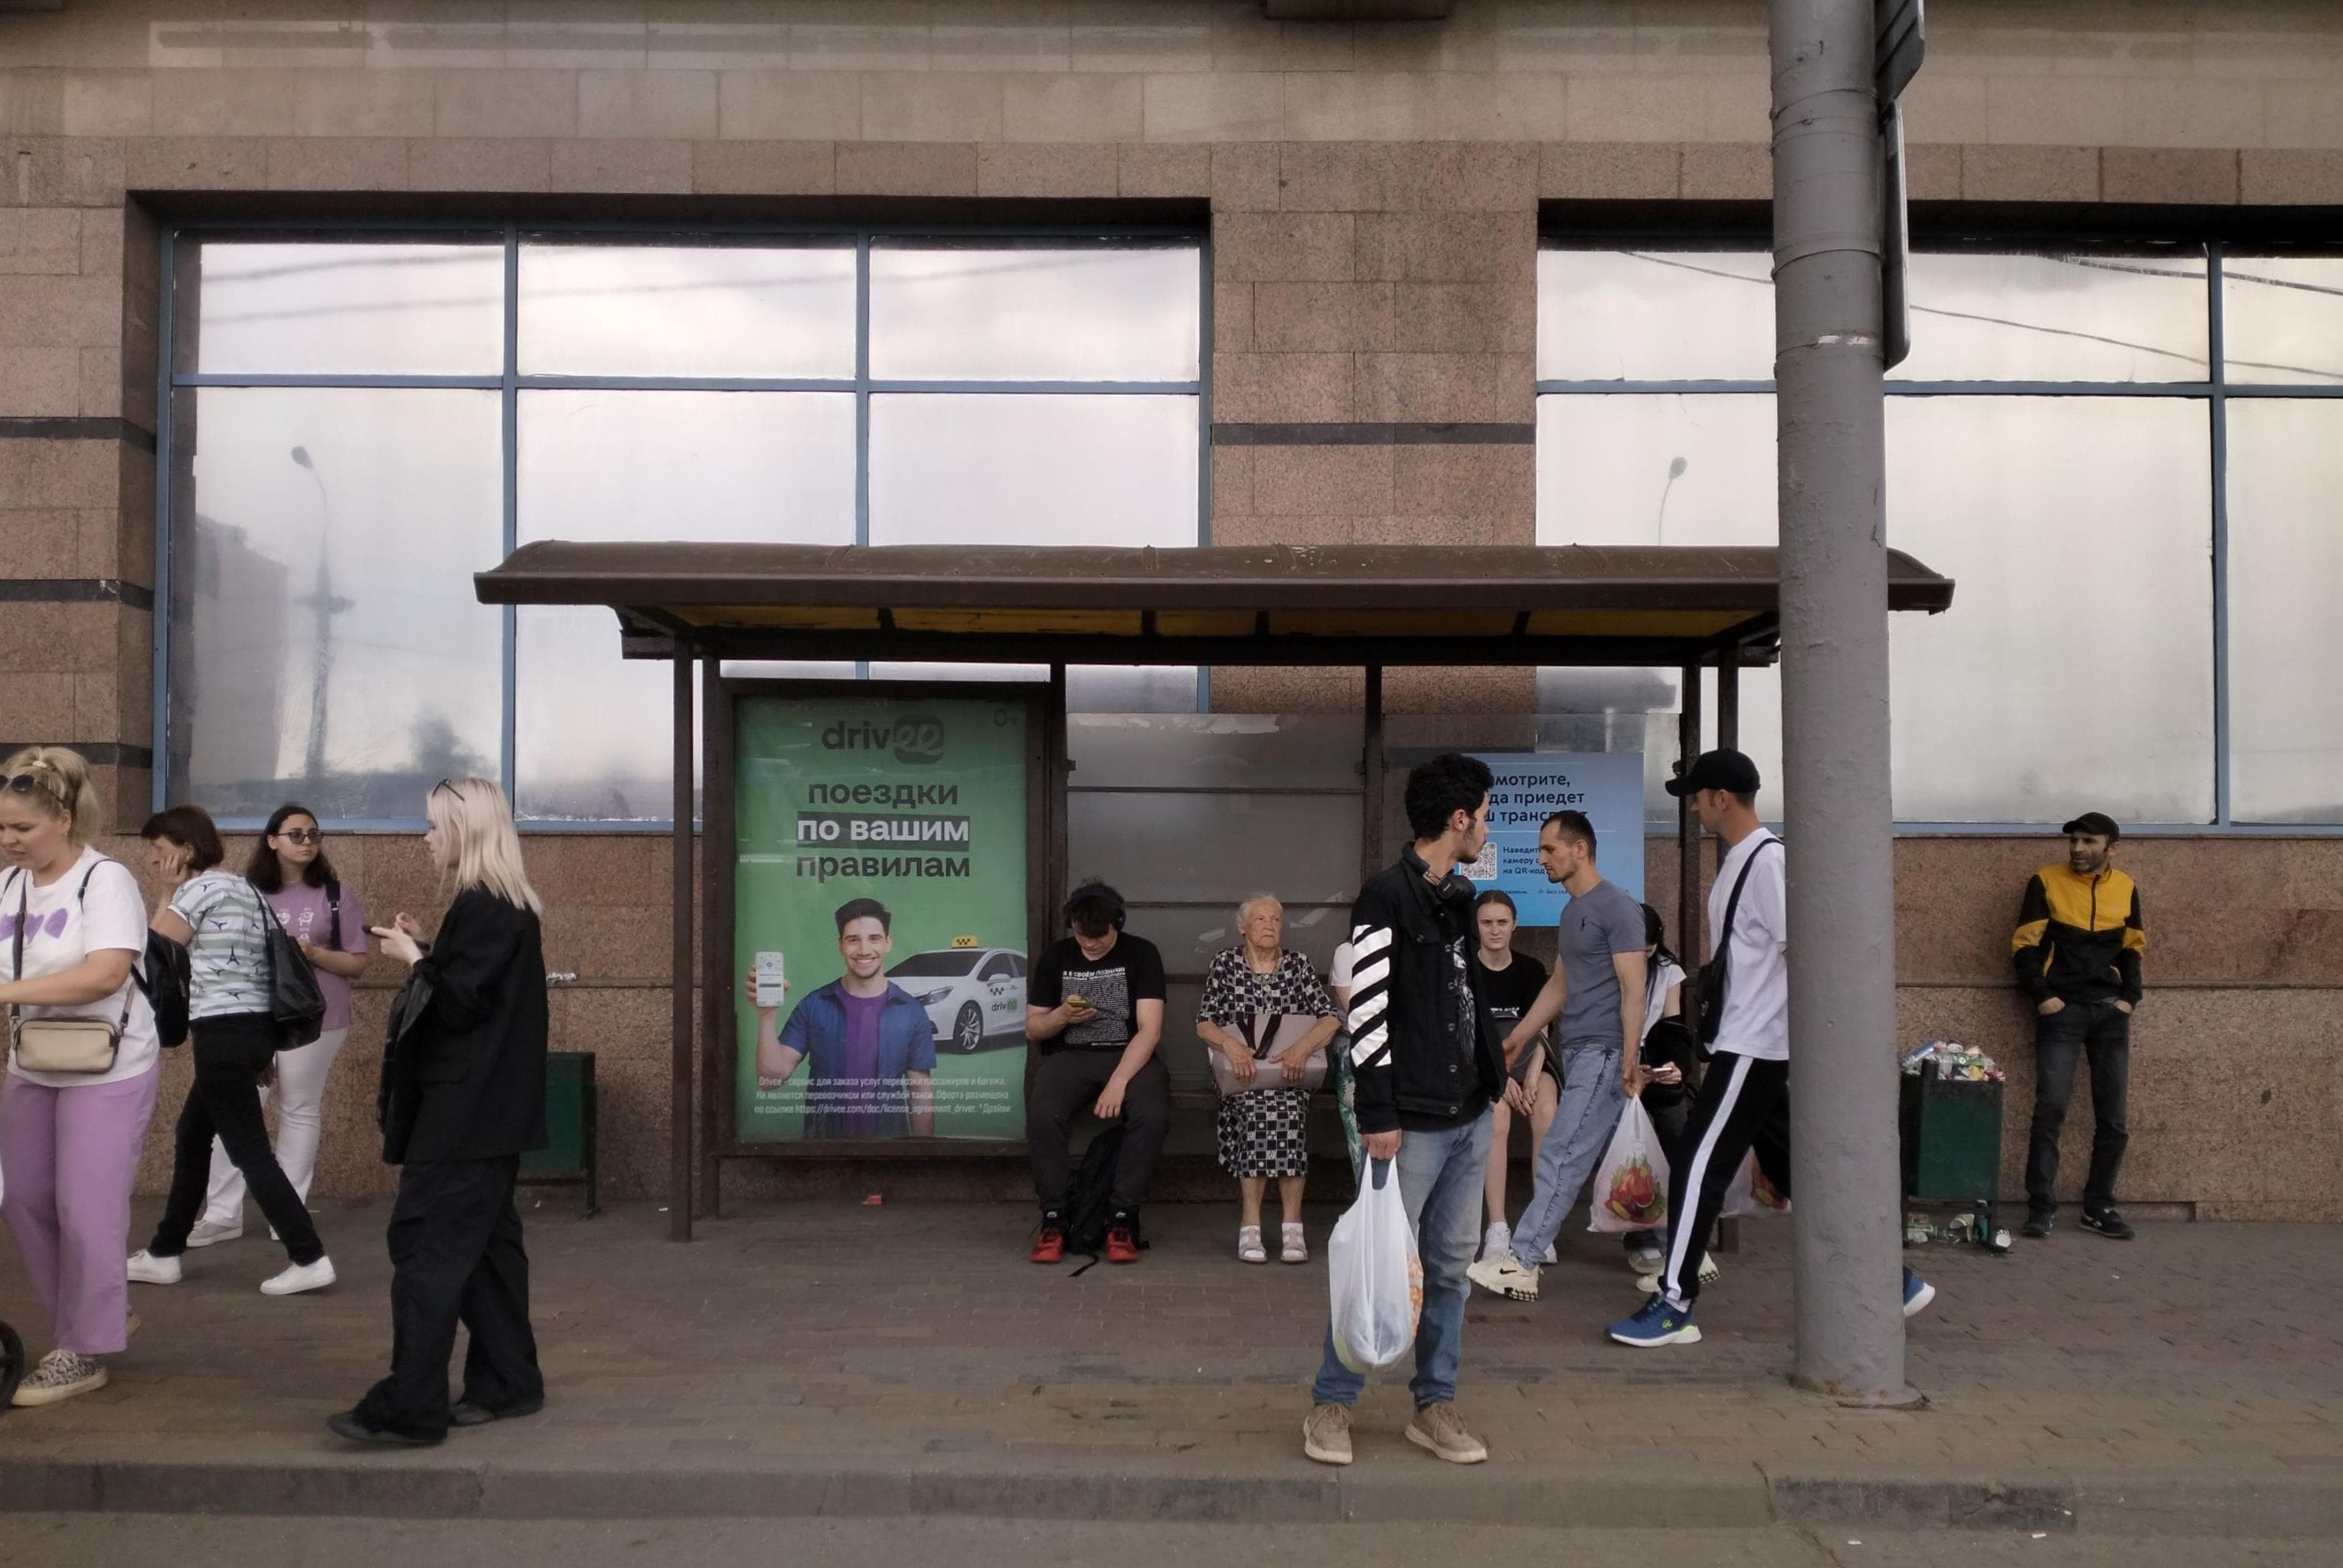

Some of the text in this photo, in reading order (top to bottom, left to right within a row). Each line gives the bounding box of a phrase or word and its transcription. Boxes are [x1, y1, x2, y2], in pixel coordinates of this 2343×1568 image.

[994, 708, 1018, 727] 0+
[1495, 775, 1570, 789] мотрите,
[808, 782, 958, 808] поездки
[1514, 792, 1585, 807] приедет
[797, 819, 969, 841] по вашим
[796, 856, 970, 883] правилам
[1515, 867, 1545, 875] QR-код
[759, 1076, 783, 1086] Drivee
[788, 1078, 815, 1086] сервис
[816, 1078, 832, 1086] для
[860, 1078, 881, 1087] услуг
[882, 1078, 922, 1087] перевозки
[923, 1077, 969, 1087] пассажиров
[756, 1091, 766, 1099] Не
[805, 1092, 859, 1101] перевозчиком
[877, 1090, 910, 1101] службой
[936, 1090, 965, 1101] Оферта
[966, 1092, 1009, 1101] размещена
[754, 1106, 764, 1114] по
[765, 1106, 794, 1114] ссылке
